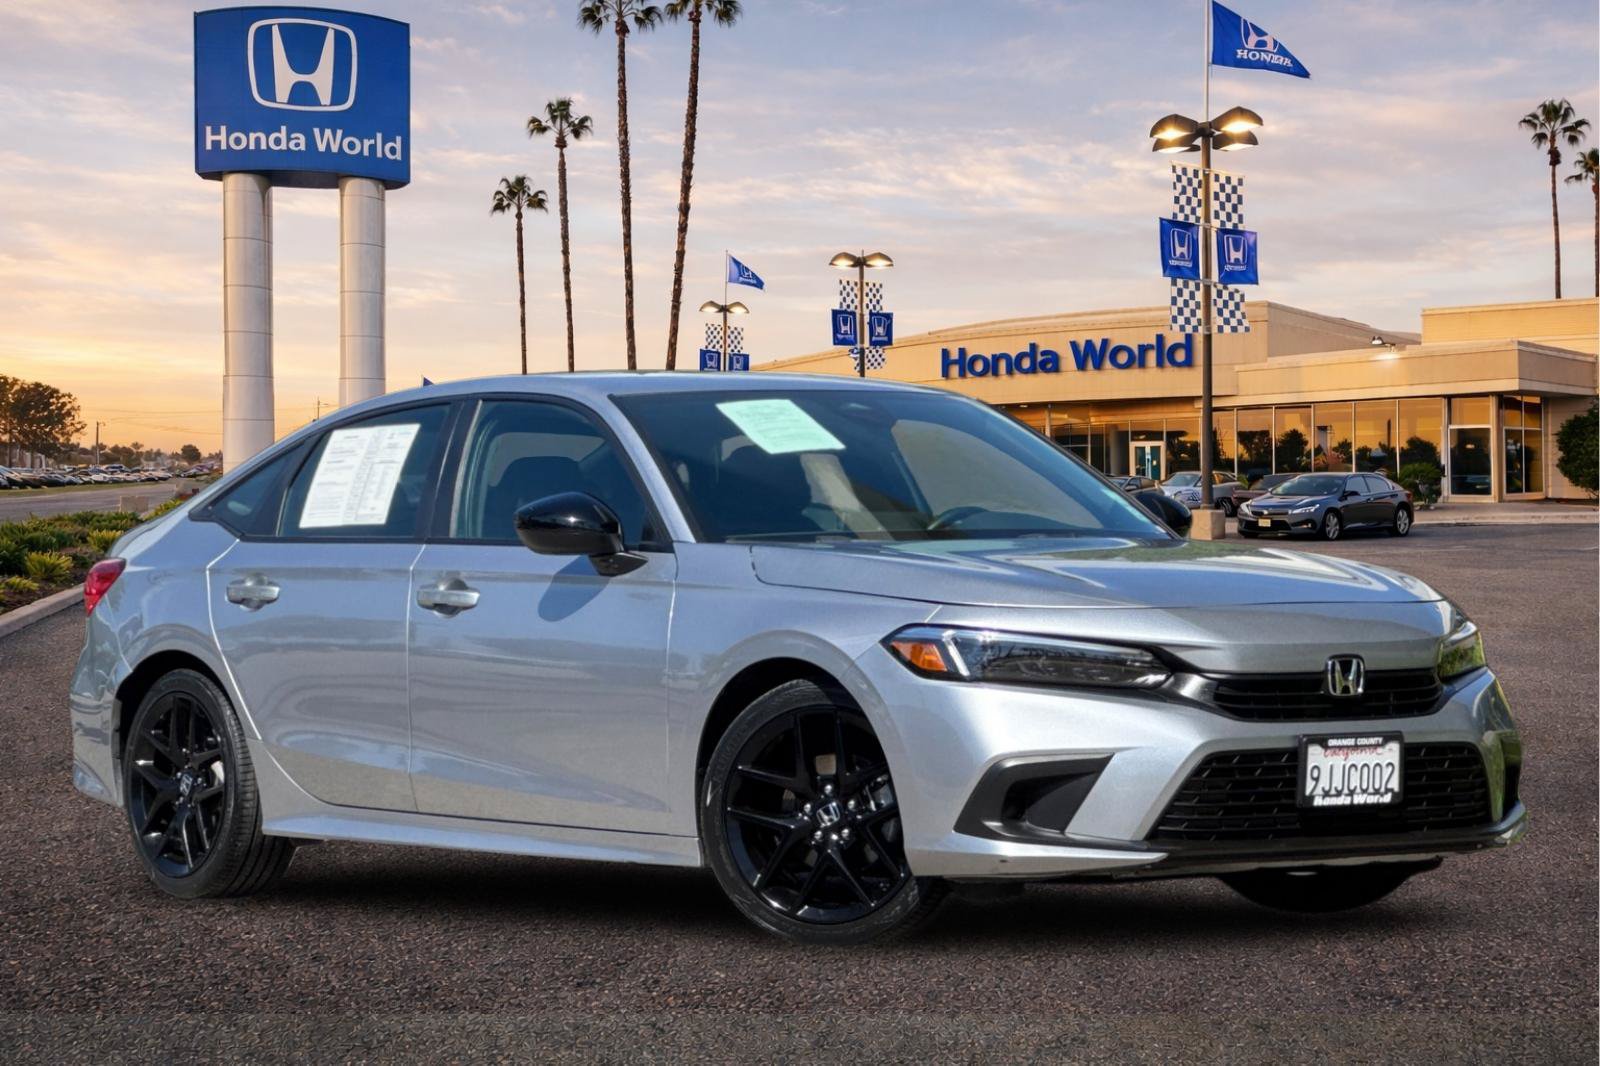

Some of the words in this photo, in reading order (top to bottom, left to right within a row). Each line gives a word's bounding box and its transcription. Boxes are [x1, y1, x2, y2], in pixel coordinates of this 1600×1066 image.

[205, 125, 306, 151] Honda
[313, 127, 402, 161] World
[941, 342, 1060, 378] Honda
[1070, 333, 1194, 371] World
[1327, 738, 1356, 747] ORANGE
[1356, 737, 1384, 746] COUNTY
[1310, 762, 1395, 797] 9JJC002
